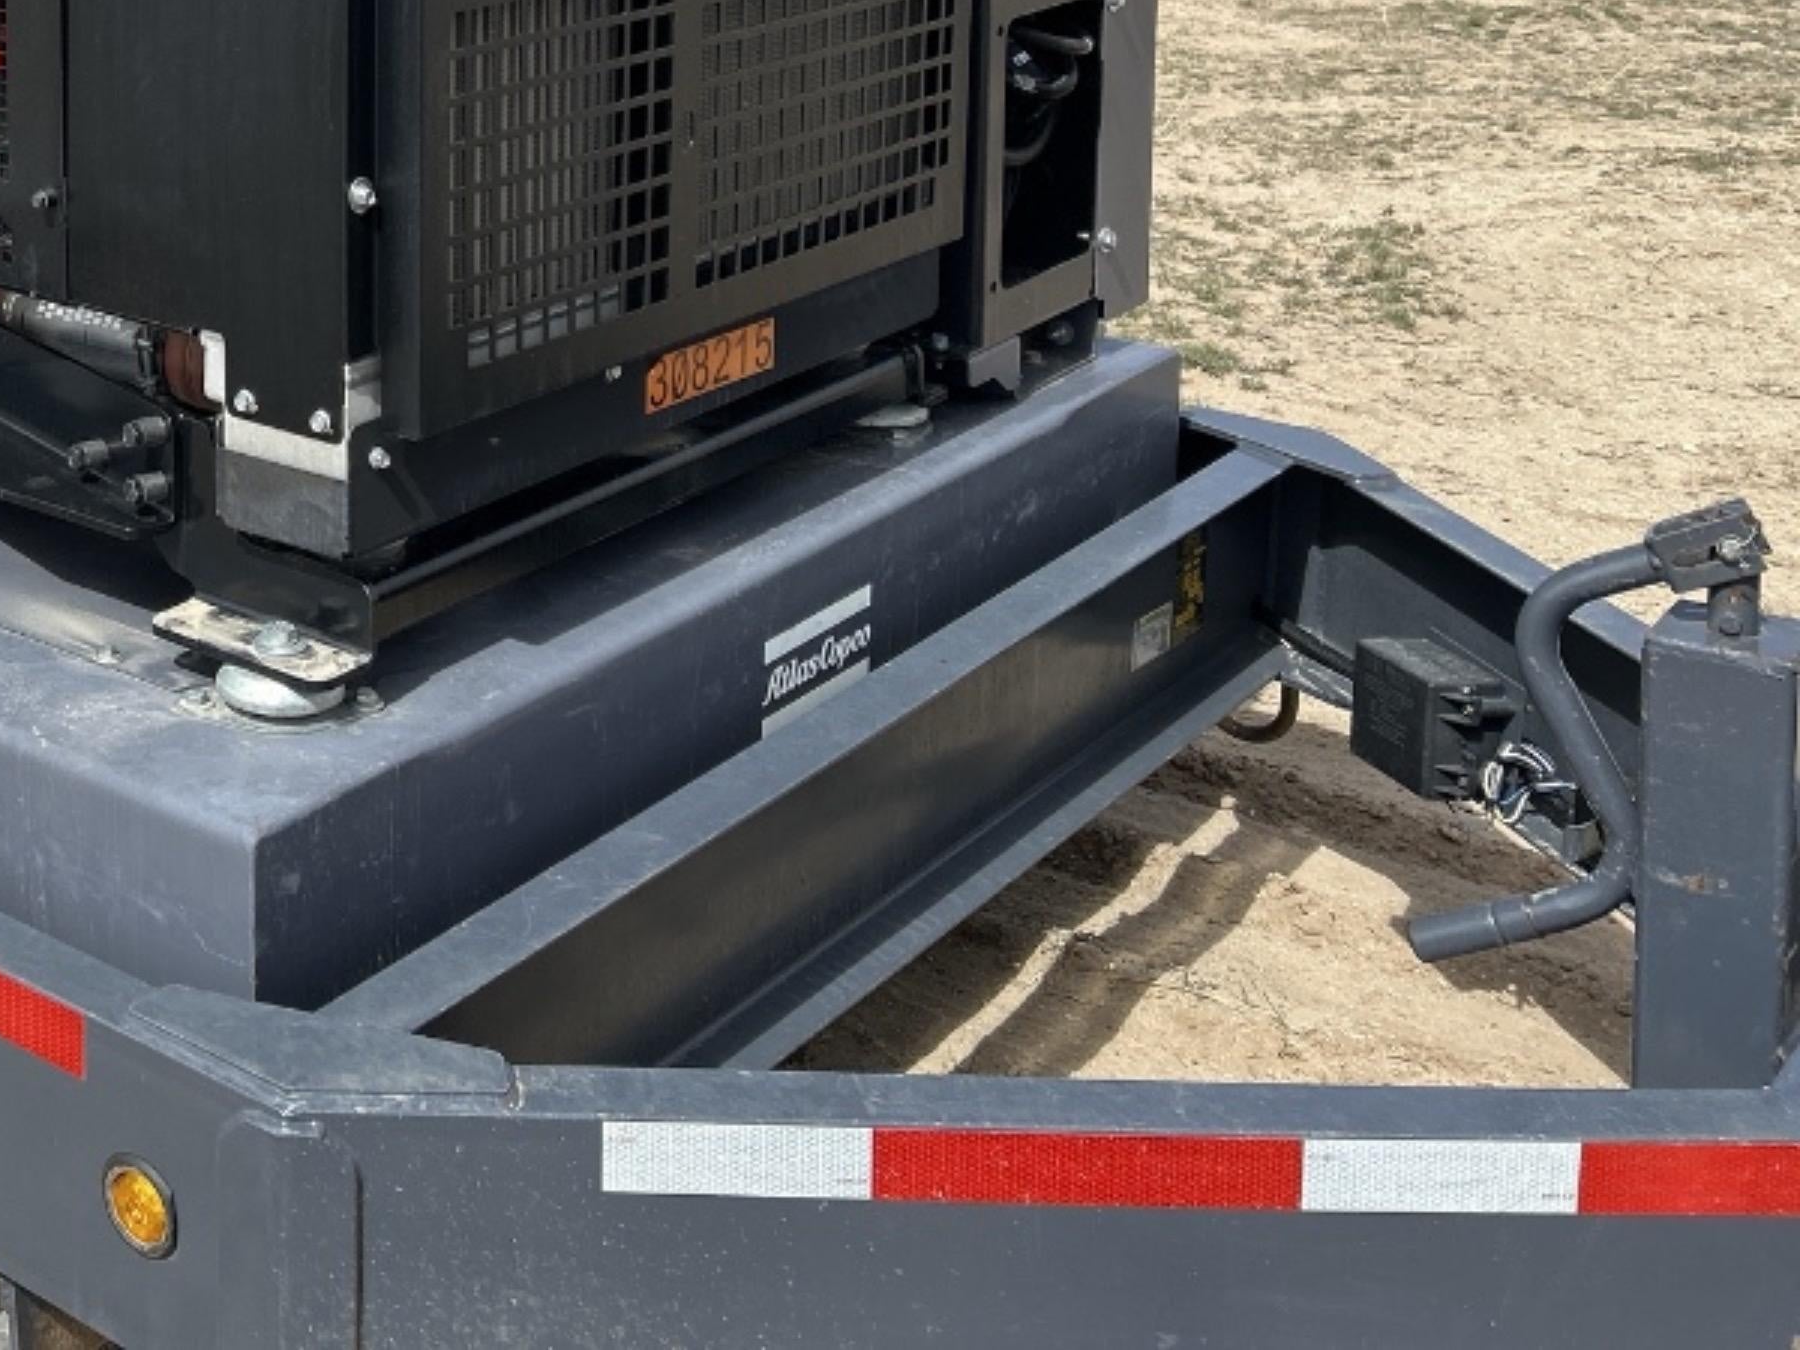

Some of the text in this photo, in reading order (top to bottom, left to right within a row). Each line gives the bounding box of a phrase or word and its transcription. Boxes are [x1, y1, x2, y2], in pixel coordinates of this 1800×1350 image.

[650, 321, 772, 406] 308215
[761, 623, 871, 706] Atlas Copco
